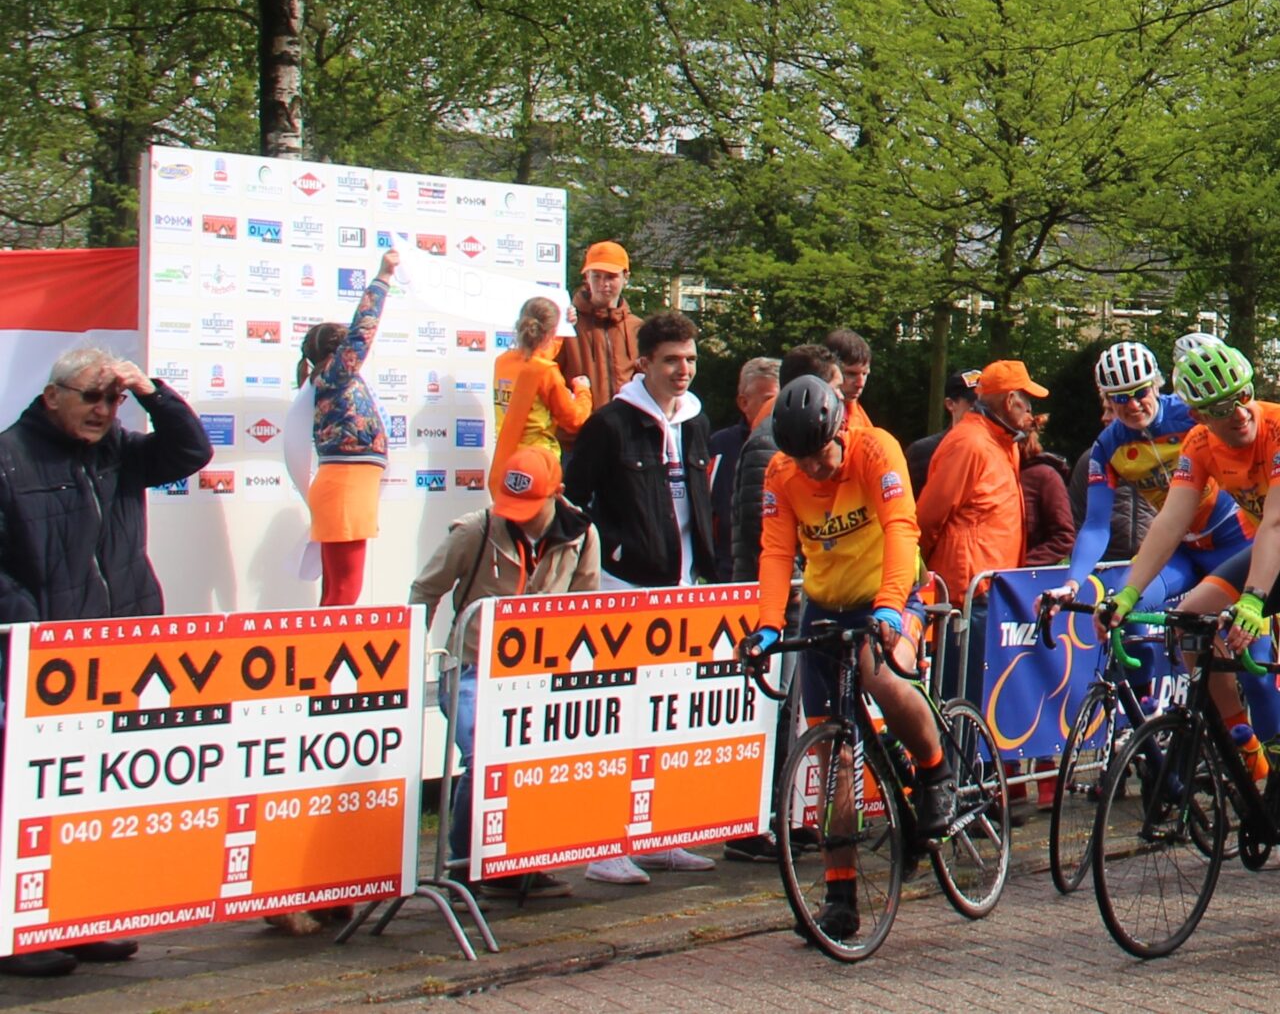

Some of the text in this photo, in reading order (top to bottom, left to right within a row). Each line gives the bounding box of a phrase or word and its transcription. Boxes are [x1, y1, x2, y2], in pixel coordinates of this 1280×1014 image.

[501, 596, 637, 616] MAKELAARDIJ
[649, 589, 761, 606] MAKELAARDI
[40, 619, 225, 642] MAKELAARDIJ
[243, 610, 405, 632] MAKELAARDIJ
[497, 621, 633, 669] OLAV
[36, 650, 223, 706] OLAV
[240, 639, 401, 691] OLAV
[502, 696, 622, 747] TE HUUR
[649, 686, 756, 733] TE HUUR
[29, 743, 224, 799] TE KOOP
[237, 726, 402, 778] TE KOOP
[638, 741, 761, 773] T 040 22 33 345
[490, 756, 627, 792] T 040 22 33 345
[235, 786, 399, 825] T 040 22 33 345
[27, 806, 220, 849] T 040 22 33 345
[632, 822, 755, 853] WWW.MAKELAARDIJOLAV.NL
[485, 843, 623, 874] WWW.MAKELAARDIJOLAV.NL
[224, 880, 396, 917] WWW.MAKELAARDIJOLAV.NL
[18, 906, 214, 947] WWW.MAKELAARDIJOLAV.NL
